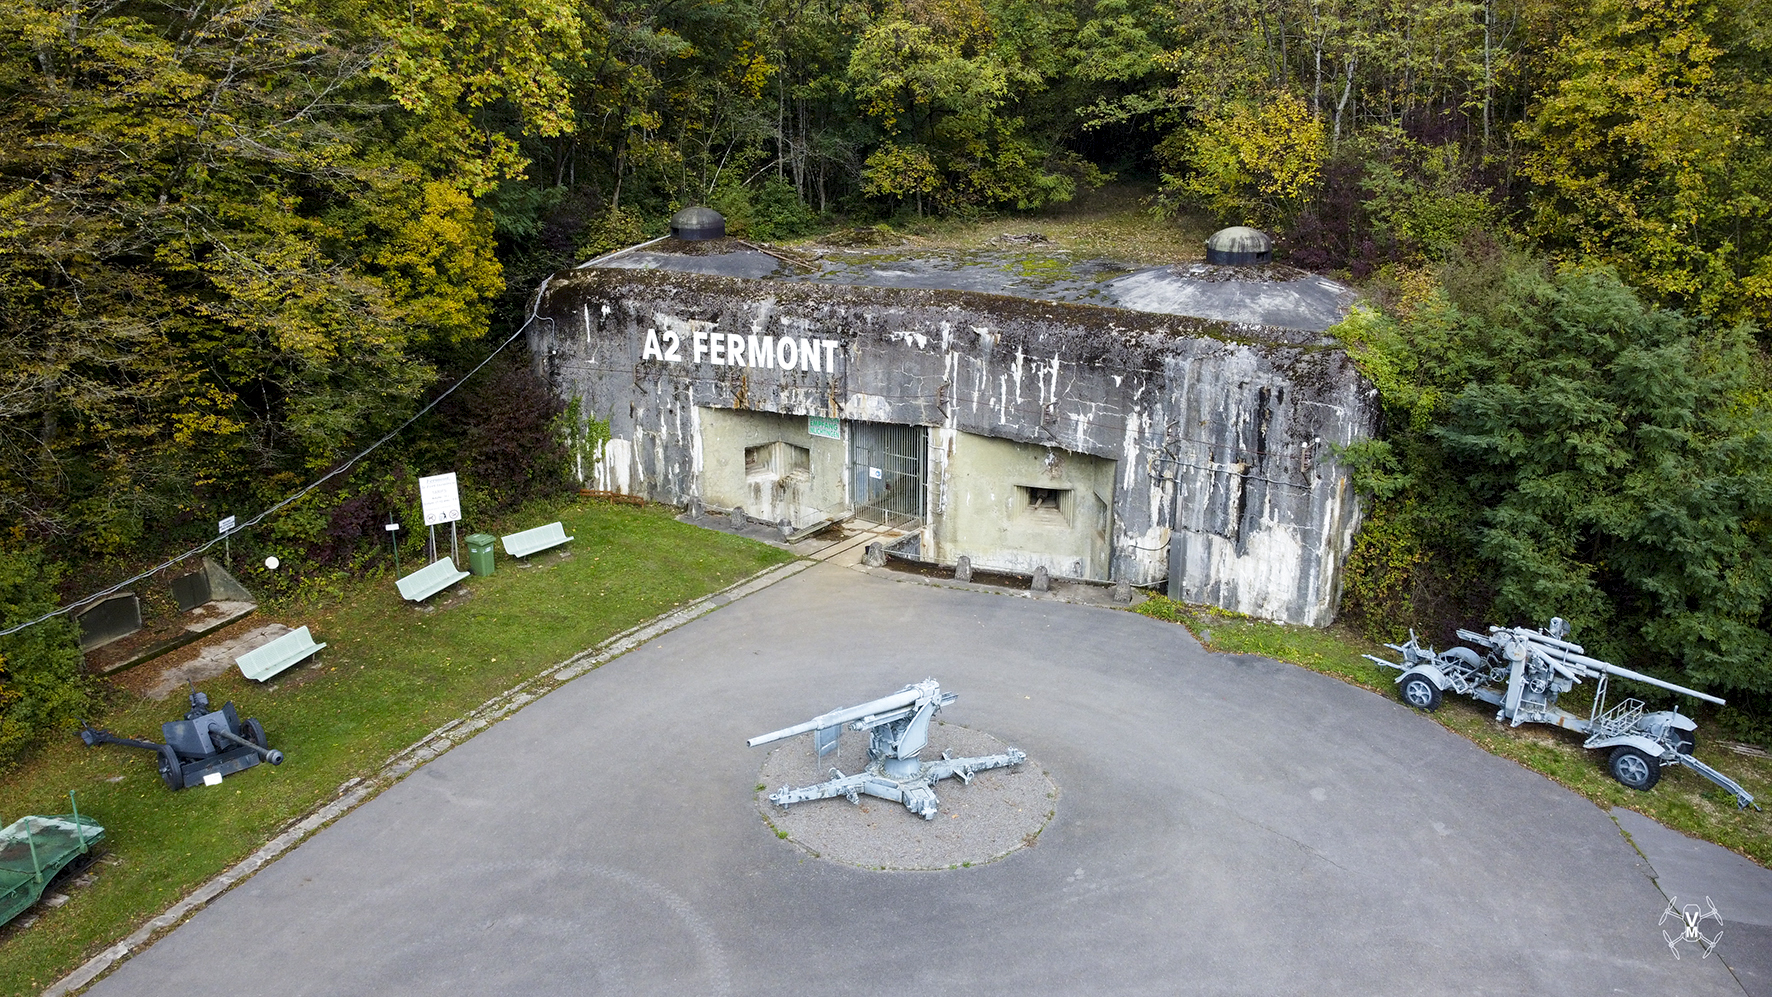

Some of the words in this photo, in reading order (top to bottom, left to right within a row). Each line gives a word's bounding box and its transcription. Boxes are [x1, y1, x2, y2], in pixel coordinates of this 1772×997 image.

[642, 328, 682, 362] A2
[693, 331, 838, 373] FERMONT
[810, 418, 838, 431] EMPFANG
